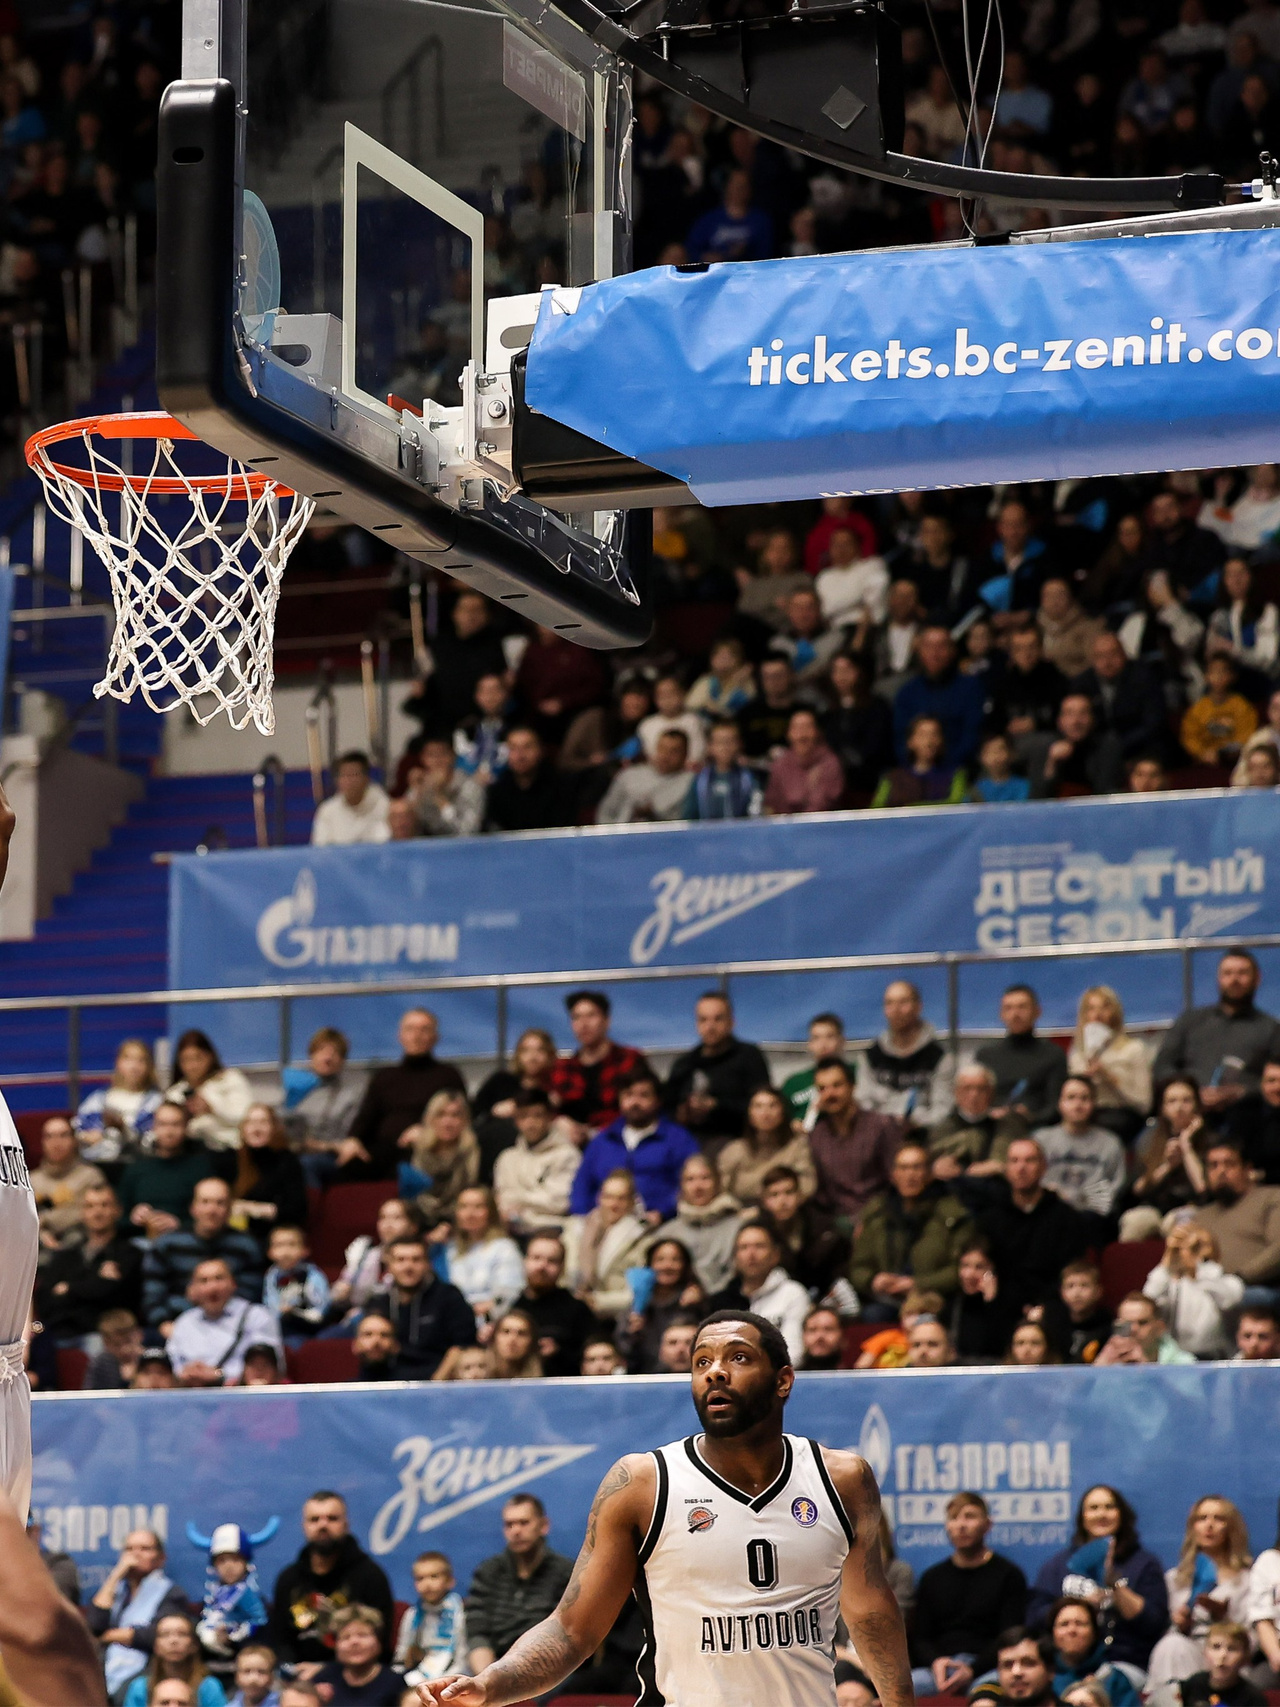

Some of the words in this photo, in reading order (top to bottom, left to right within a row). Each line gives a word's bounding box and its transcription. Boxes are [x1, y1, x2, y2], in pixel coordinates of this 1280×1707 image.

[748, 316, 1280, 386] tickets.bc-zenit.co
[974, 848, 1266, 916] ДЕСЯТЫЙ
[976, 906, 1176, 950] СЕЗОН
[894, 1440, 1070, 1493] ГАЗПРОМ
[32, 1504, 169, 1553] ЗПРОМ
[746, 1538, 779, 1592] 0
[700, 1608, 824, 1655] AVTODOR
